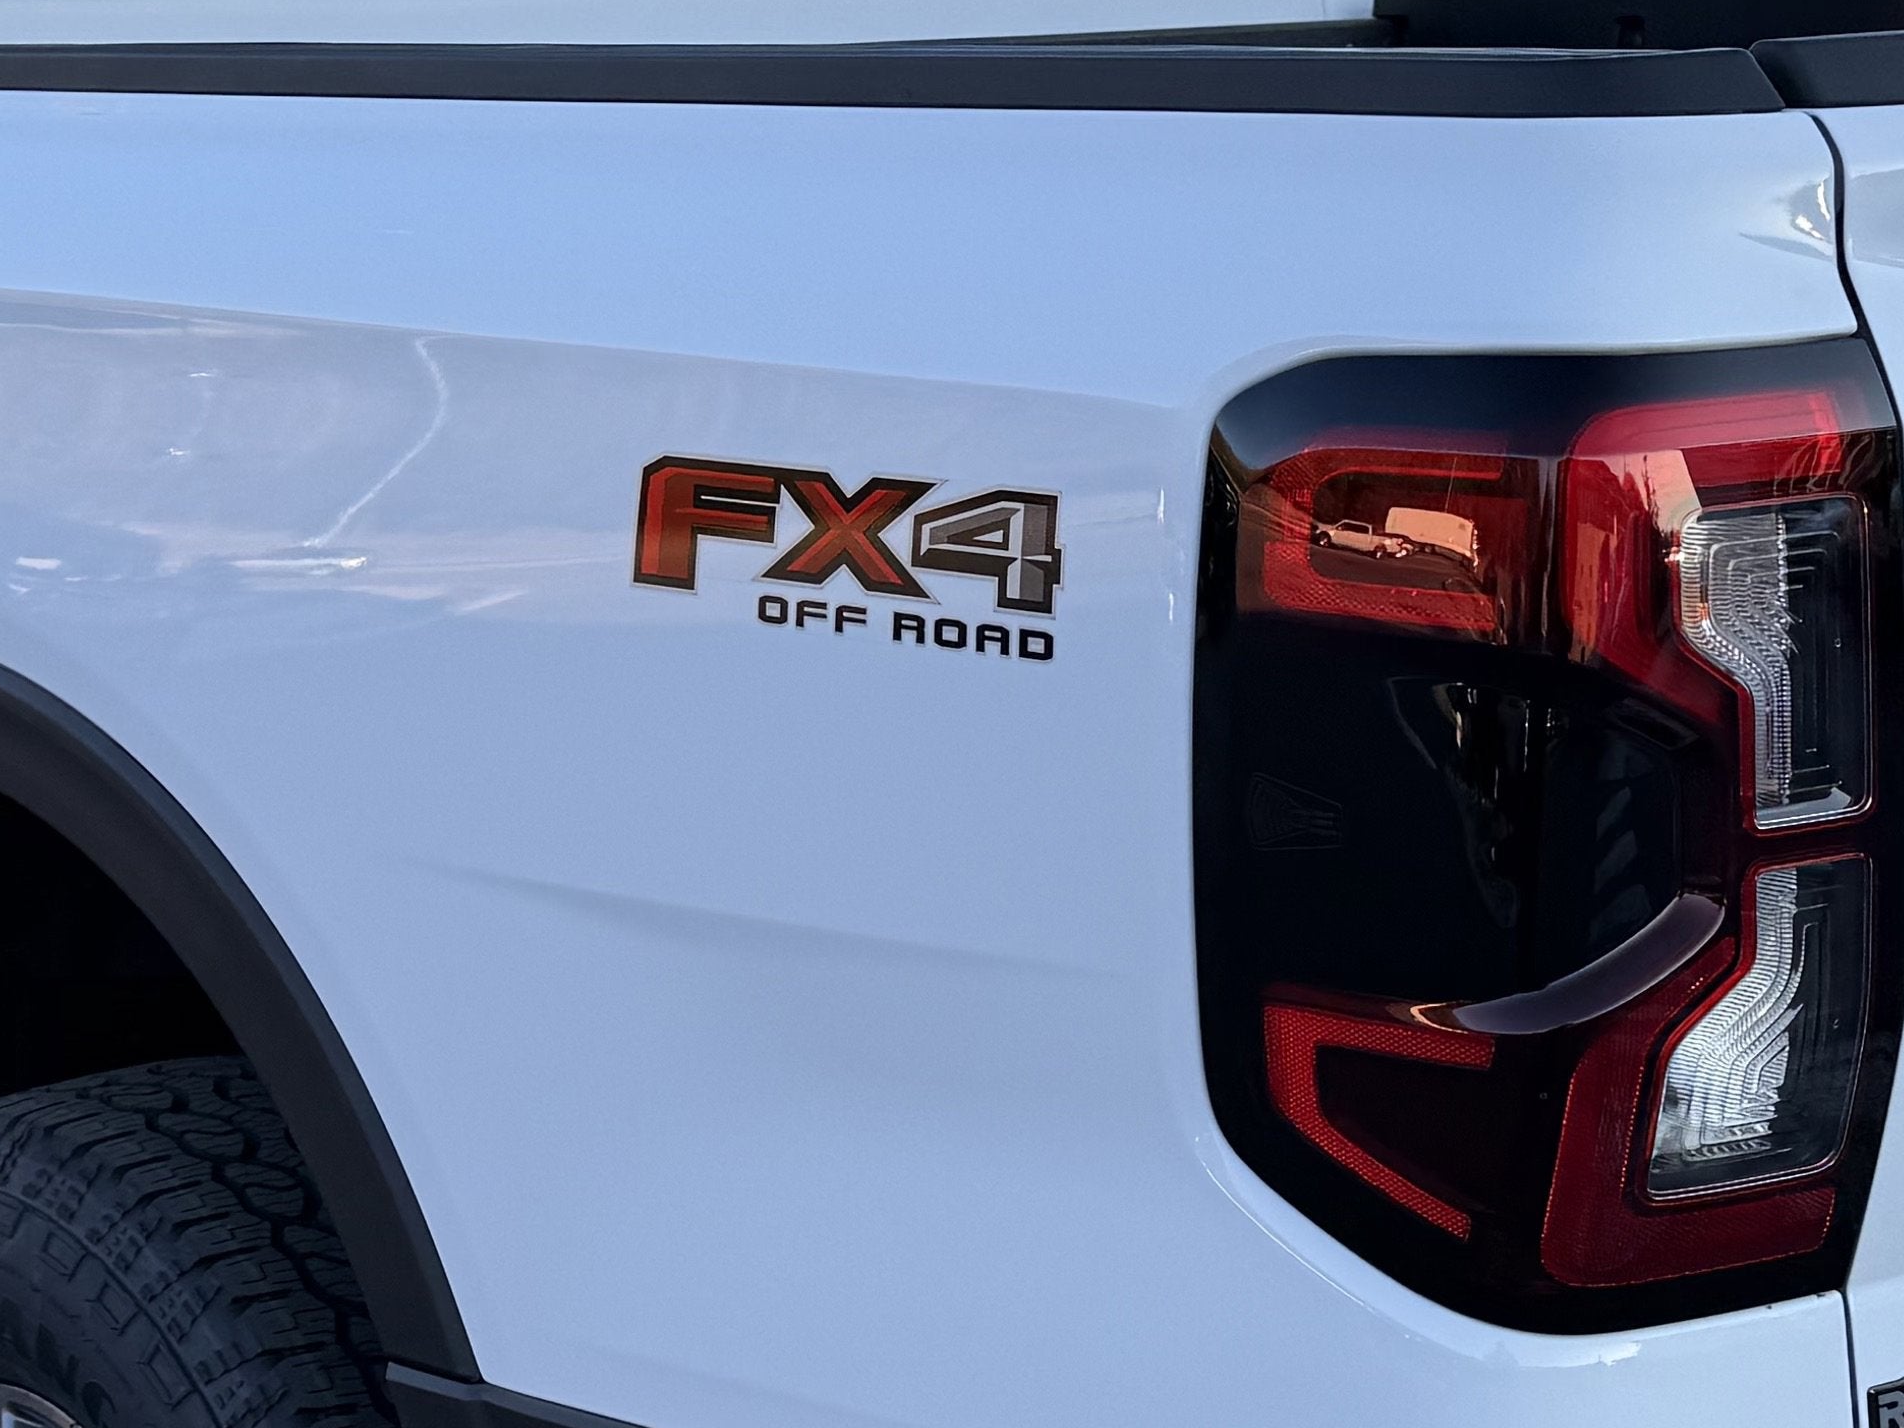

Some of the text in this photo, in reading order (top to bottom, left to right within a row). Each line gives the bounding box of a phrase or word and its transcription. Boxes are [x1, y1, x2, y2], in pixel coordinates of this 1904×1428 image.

[631, 452, 1065, 620] FX4
[756, 593, 1055, 663] OFF ROAD
